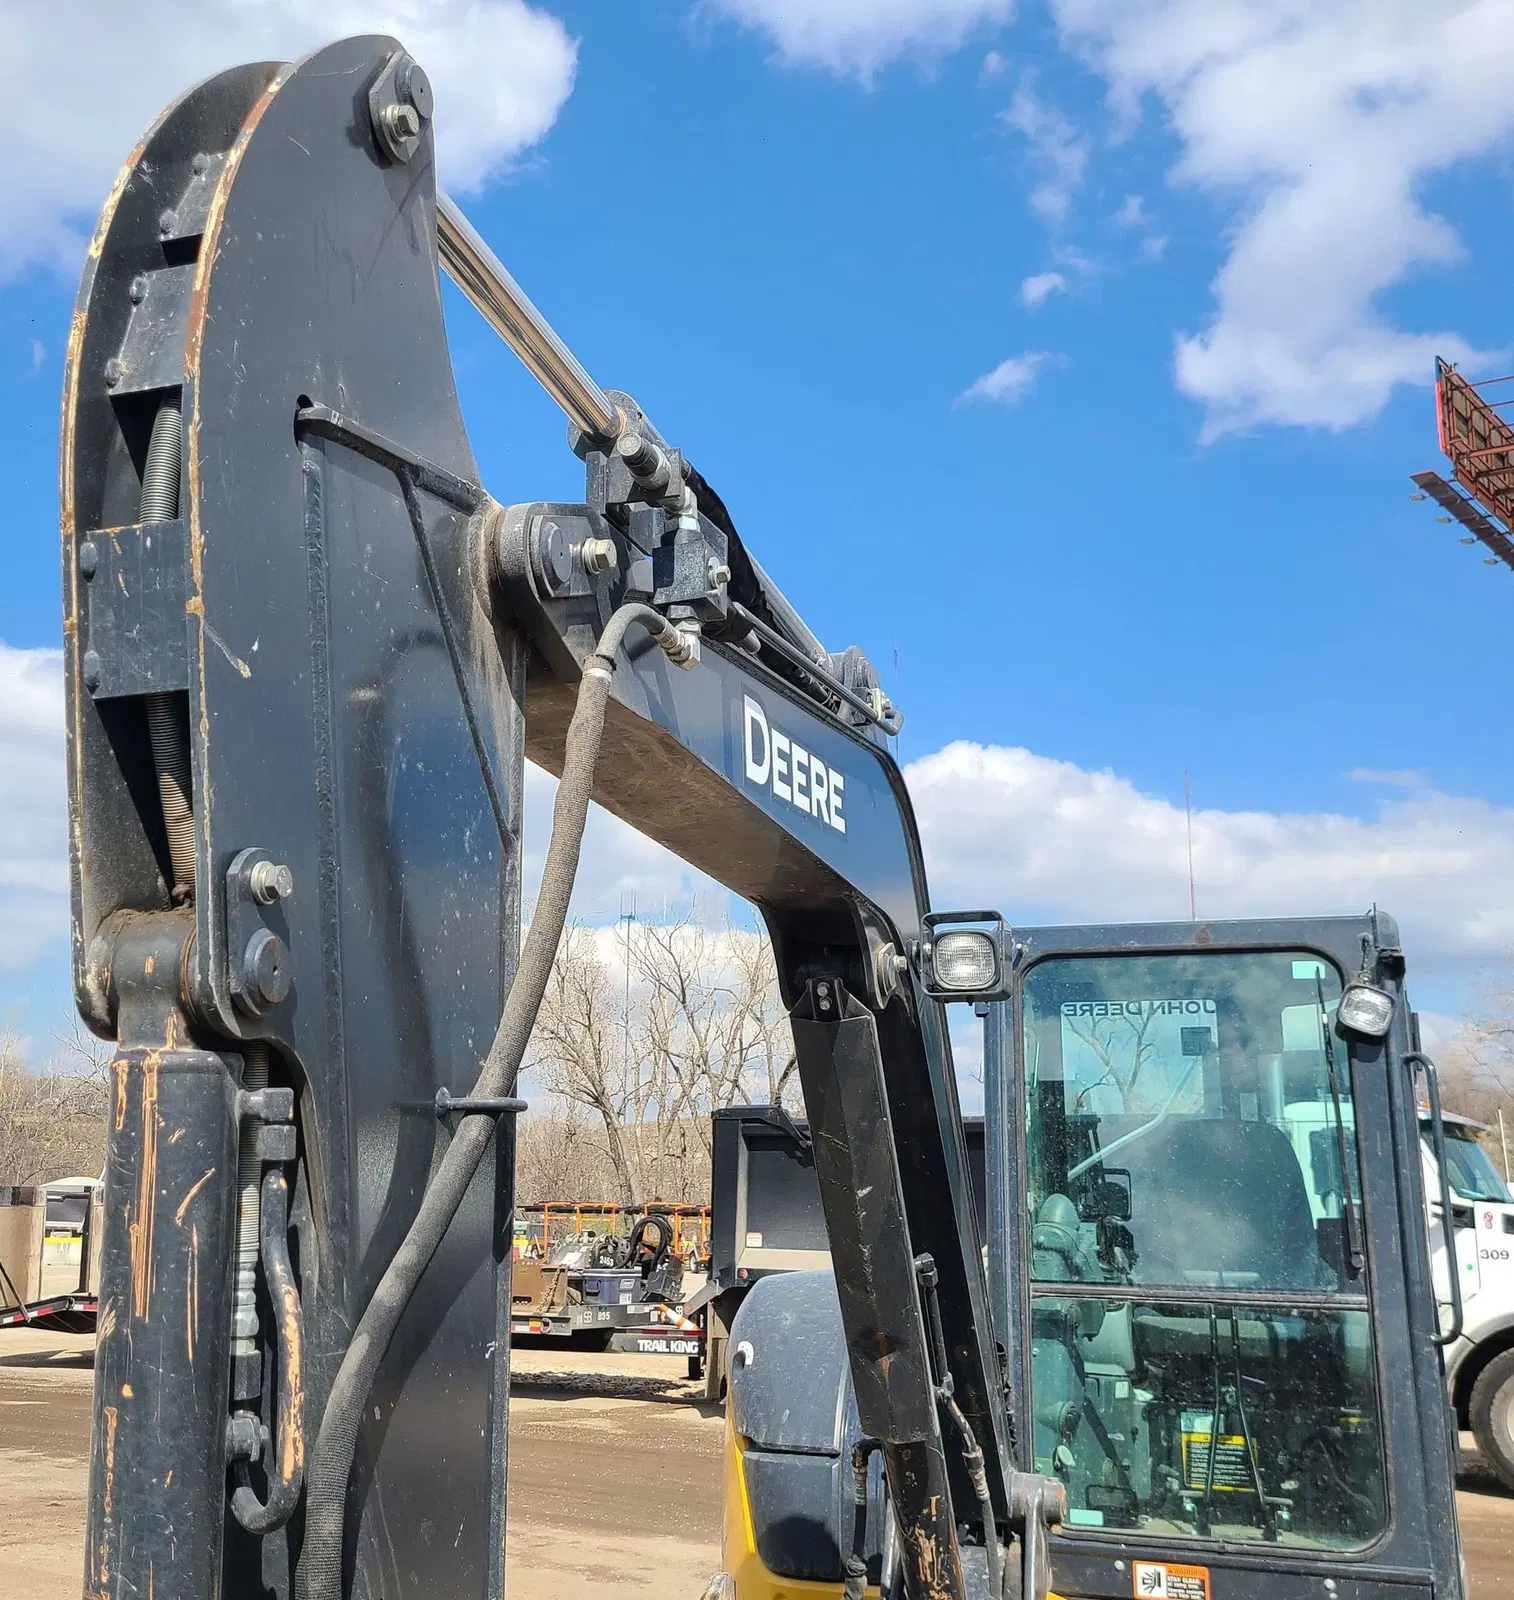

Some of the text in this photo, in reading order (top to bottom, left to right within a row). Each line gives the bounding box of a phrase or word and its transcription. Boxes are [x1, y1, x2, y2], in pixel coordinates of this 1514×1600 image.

[744, 694, 846, 834] DEERE
[1480, 1249, 1510, 1260] 309
[597, 1311, 611, 1321] 895
[637, 1340, 699, 1353] TRAIL KING
